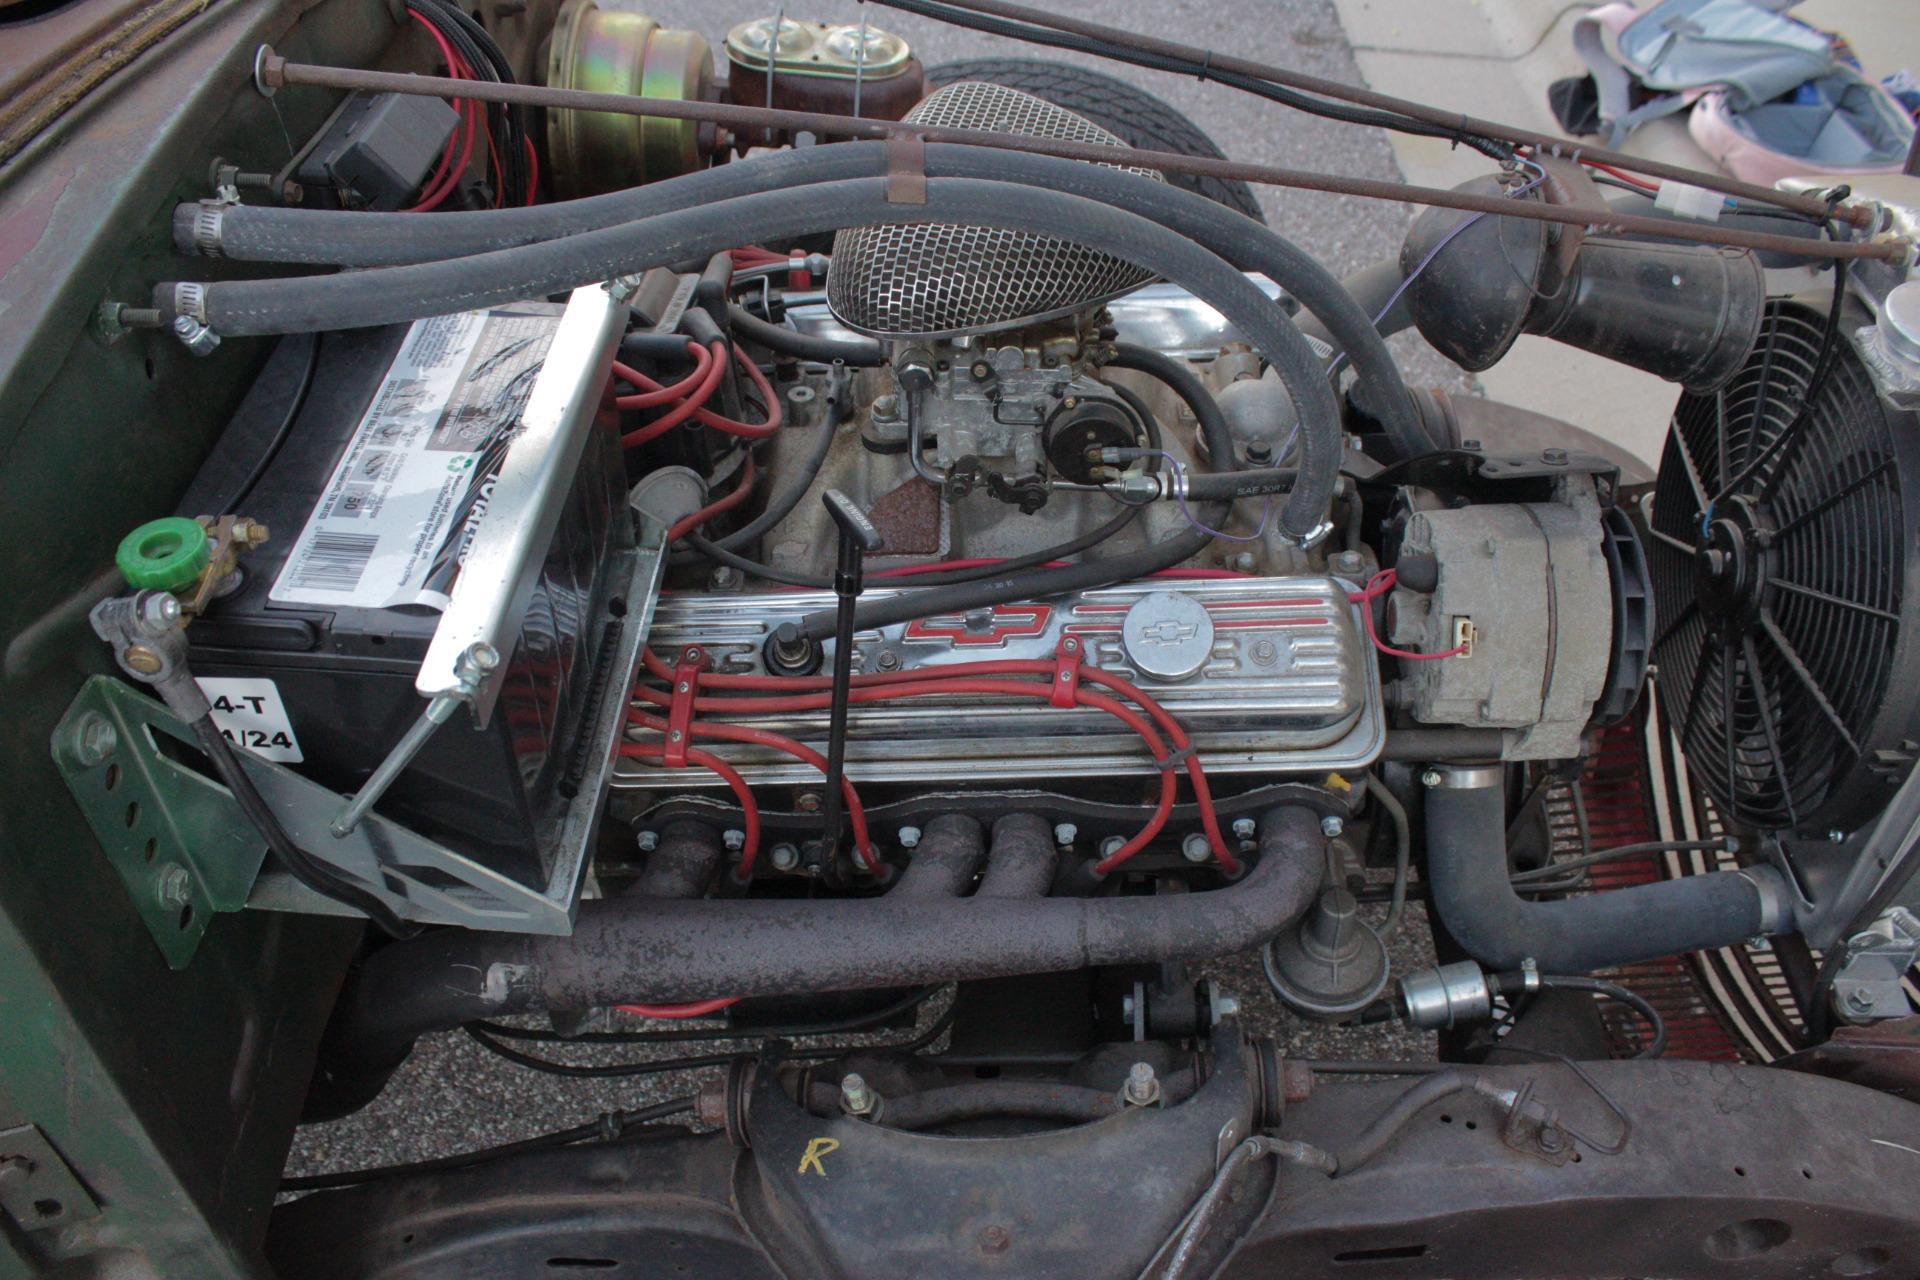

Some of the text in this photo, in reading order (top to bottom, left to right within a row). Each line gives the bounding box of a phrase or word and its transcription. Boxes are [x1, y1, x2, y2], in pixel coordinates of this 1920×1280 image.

[847, 505, 873, 530] ENGINE
[209, 695, 265, 713] 4-T
[799, 1137, 839, 1176] R
